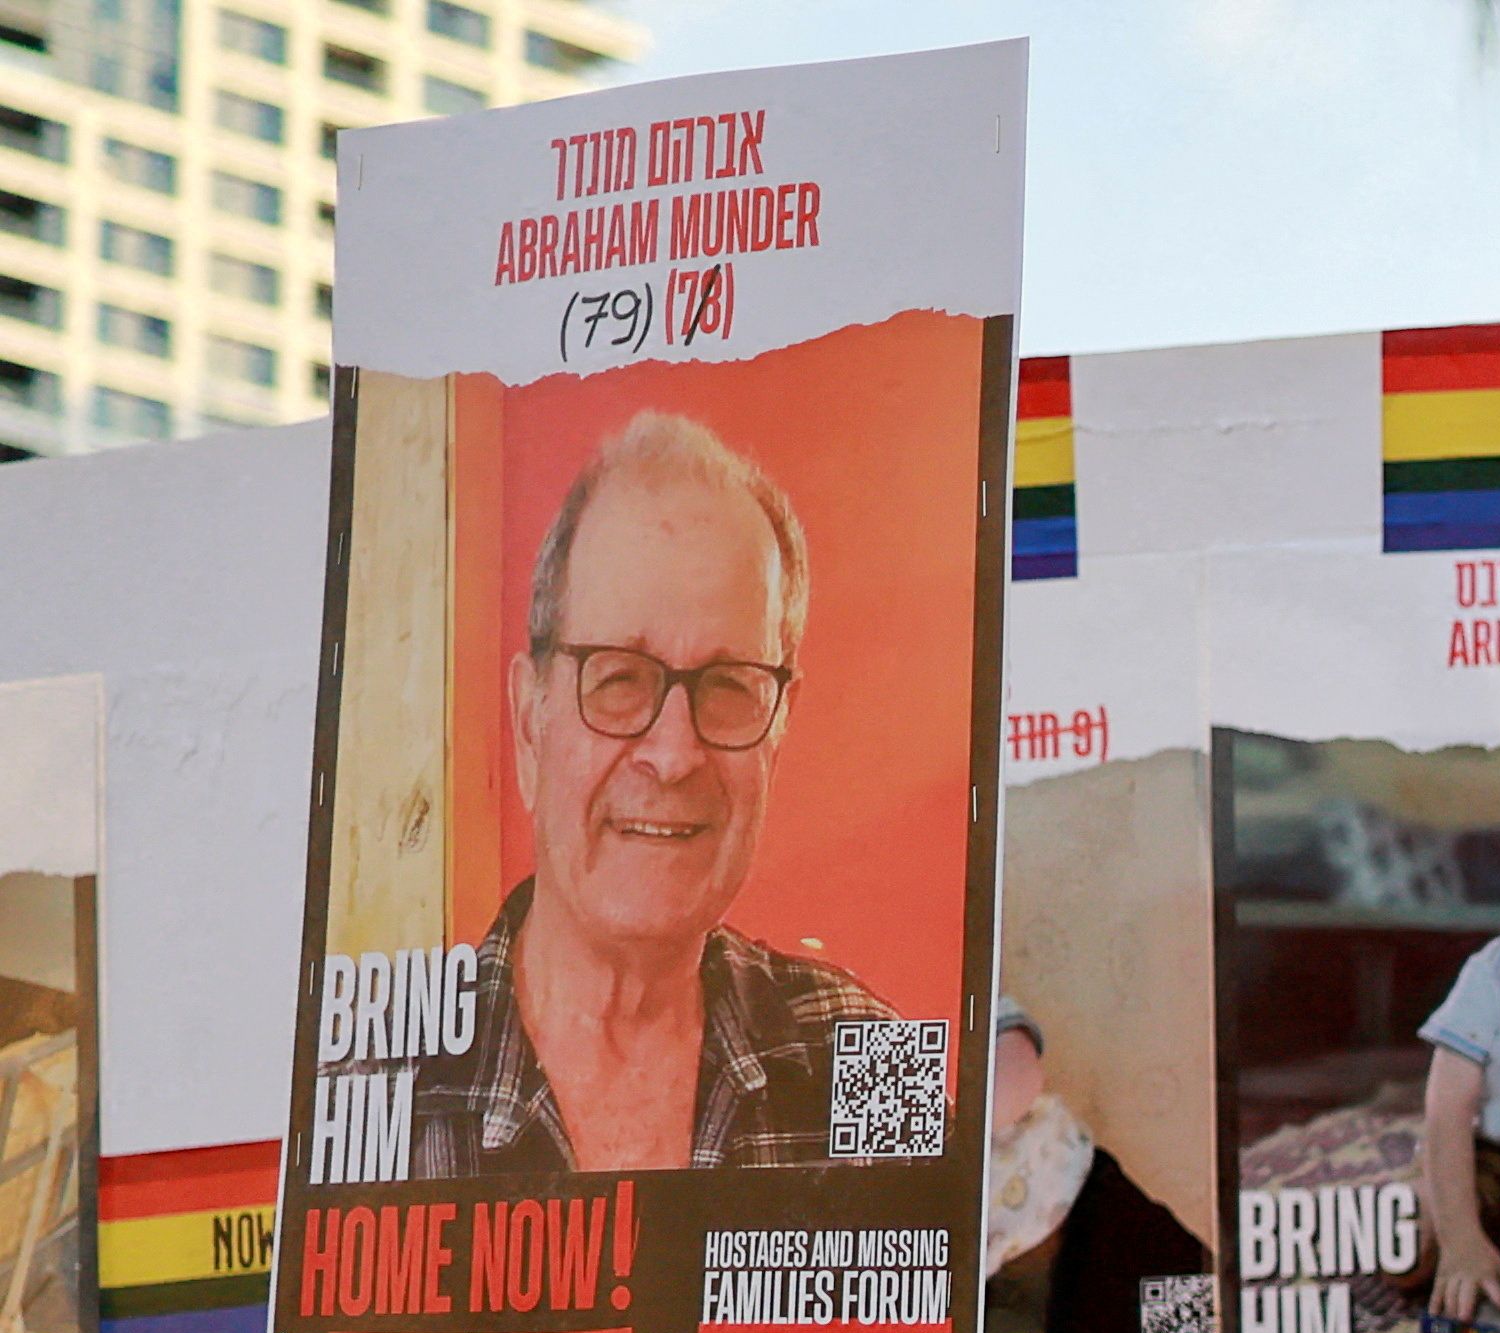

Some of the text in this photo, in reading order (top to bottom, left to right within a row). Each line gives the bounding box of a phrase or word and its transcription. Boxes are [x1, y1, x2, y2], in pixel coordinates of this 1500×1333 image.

[551, 109, 766, 201] אברהם מונדר
[495, 182, 821, 286] ABRAHAM MUNDER
[560, 282, 653, 363] (79)
[318, 943, 478, 1062] BRING
[309, 1068, 414, 1185] HIM
[299, 1181, 638, 1318] HOME NOW!
[704, 1229, 949, 1268] HOSTAGES AND MISSING
[1238, 1182, 1419, 1282] BRING
[702, 1269, 948, 1325] FAMILIES FORUM
